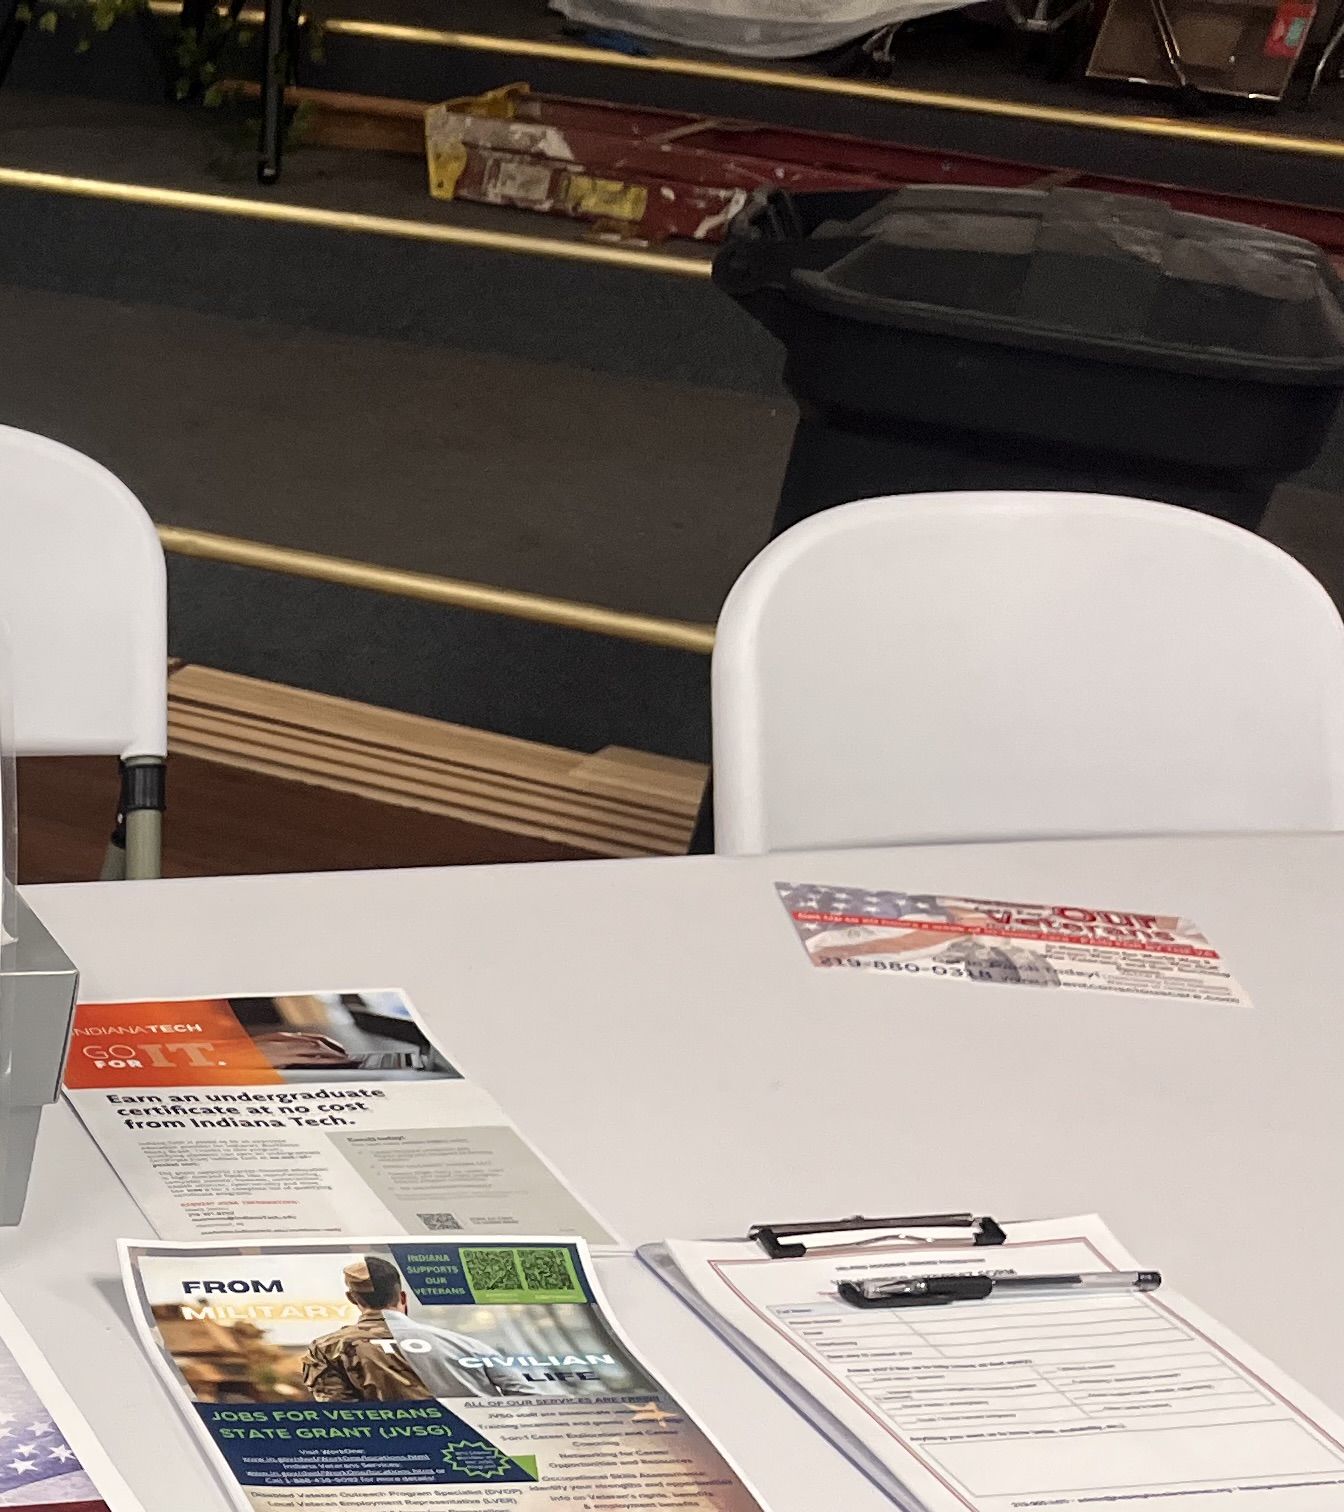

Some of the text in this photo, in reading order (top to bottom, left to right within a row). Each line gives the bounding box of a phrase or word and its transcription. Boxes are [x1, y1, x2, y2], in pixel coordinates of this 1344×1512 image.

[83, 1045, 136, 1060] GO
[95, 1060, 143, 1069] FOR
[107, 1087, 386, 1106] Earn an undergraduate
[116, 1101, 368, 1116] certificate at no cost
[124, 1115, 357, 1130] from Indiana Tech.
[406, 1253, 451, 1263] INDIANA
[407, 1265, 459, 1275] SUPPORTS
[182, 1279, 284, 1294] FROM
[425, 1276, 448, 1285] OUR
[413, 1286, 466, 1296] VETERANS
[182, 1304, 352, 1320] MILITARY
[370, 1338, 433, 1354] TO
[457, 1353, 616, 1369] CIVILIAN
[525, 1370, 602, 1382] LIFE
[213, 1408, 442, 1423] JOBS FOR VETERANS
[219, 1425, 452, 1439] STATE GRANT (JVSG)
